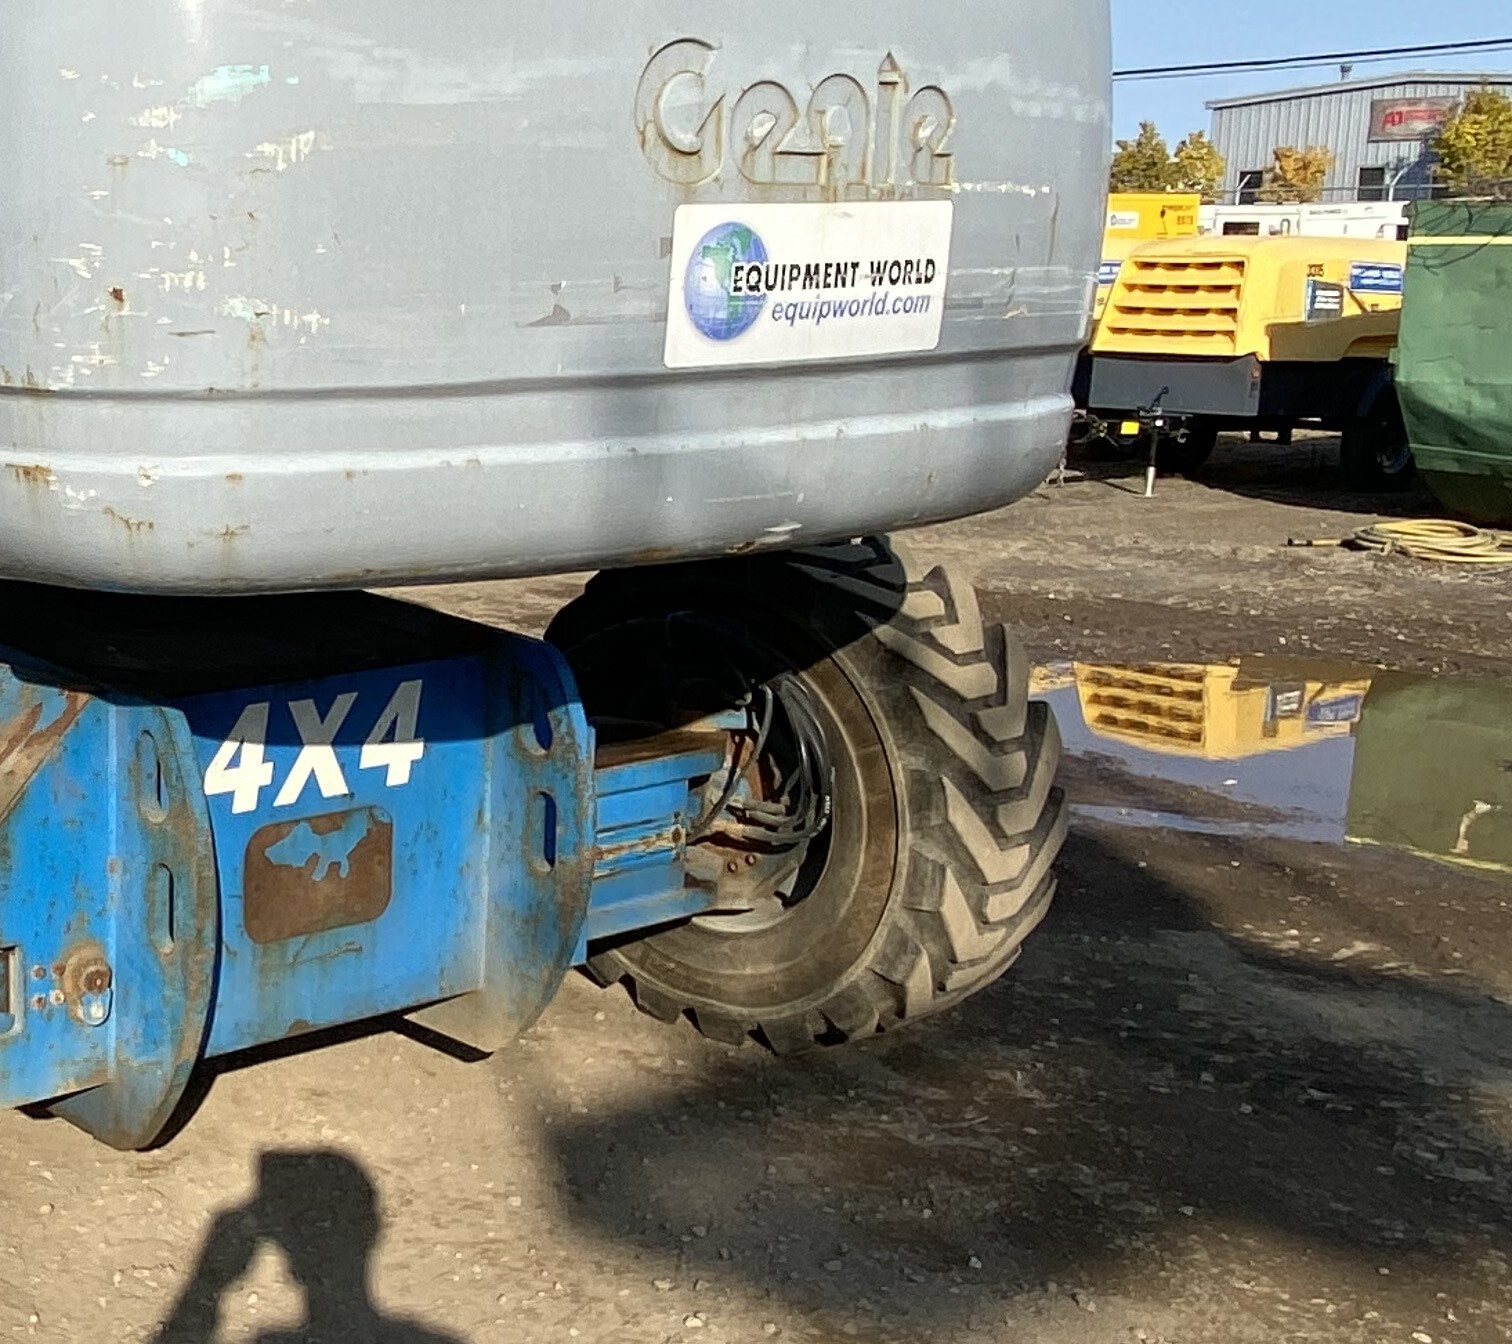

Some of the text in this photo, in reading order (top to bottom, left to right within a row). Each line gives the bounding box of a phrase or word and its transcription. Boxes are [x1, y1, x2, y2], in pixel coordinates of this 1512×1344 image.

[732, 258, 936, 293] EQUIPMENT WORLD
[771, 293, 930, 327] equipworld.com
[204, 680, 425, 814] 4X4
